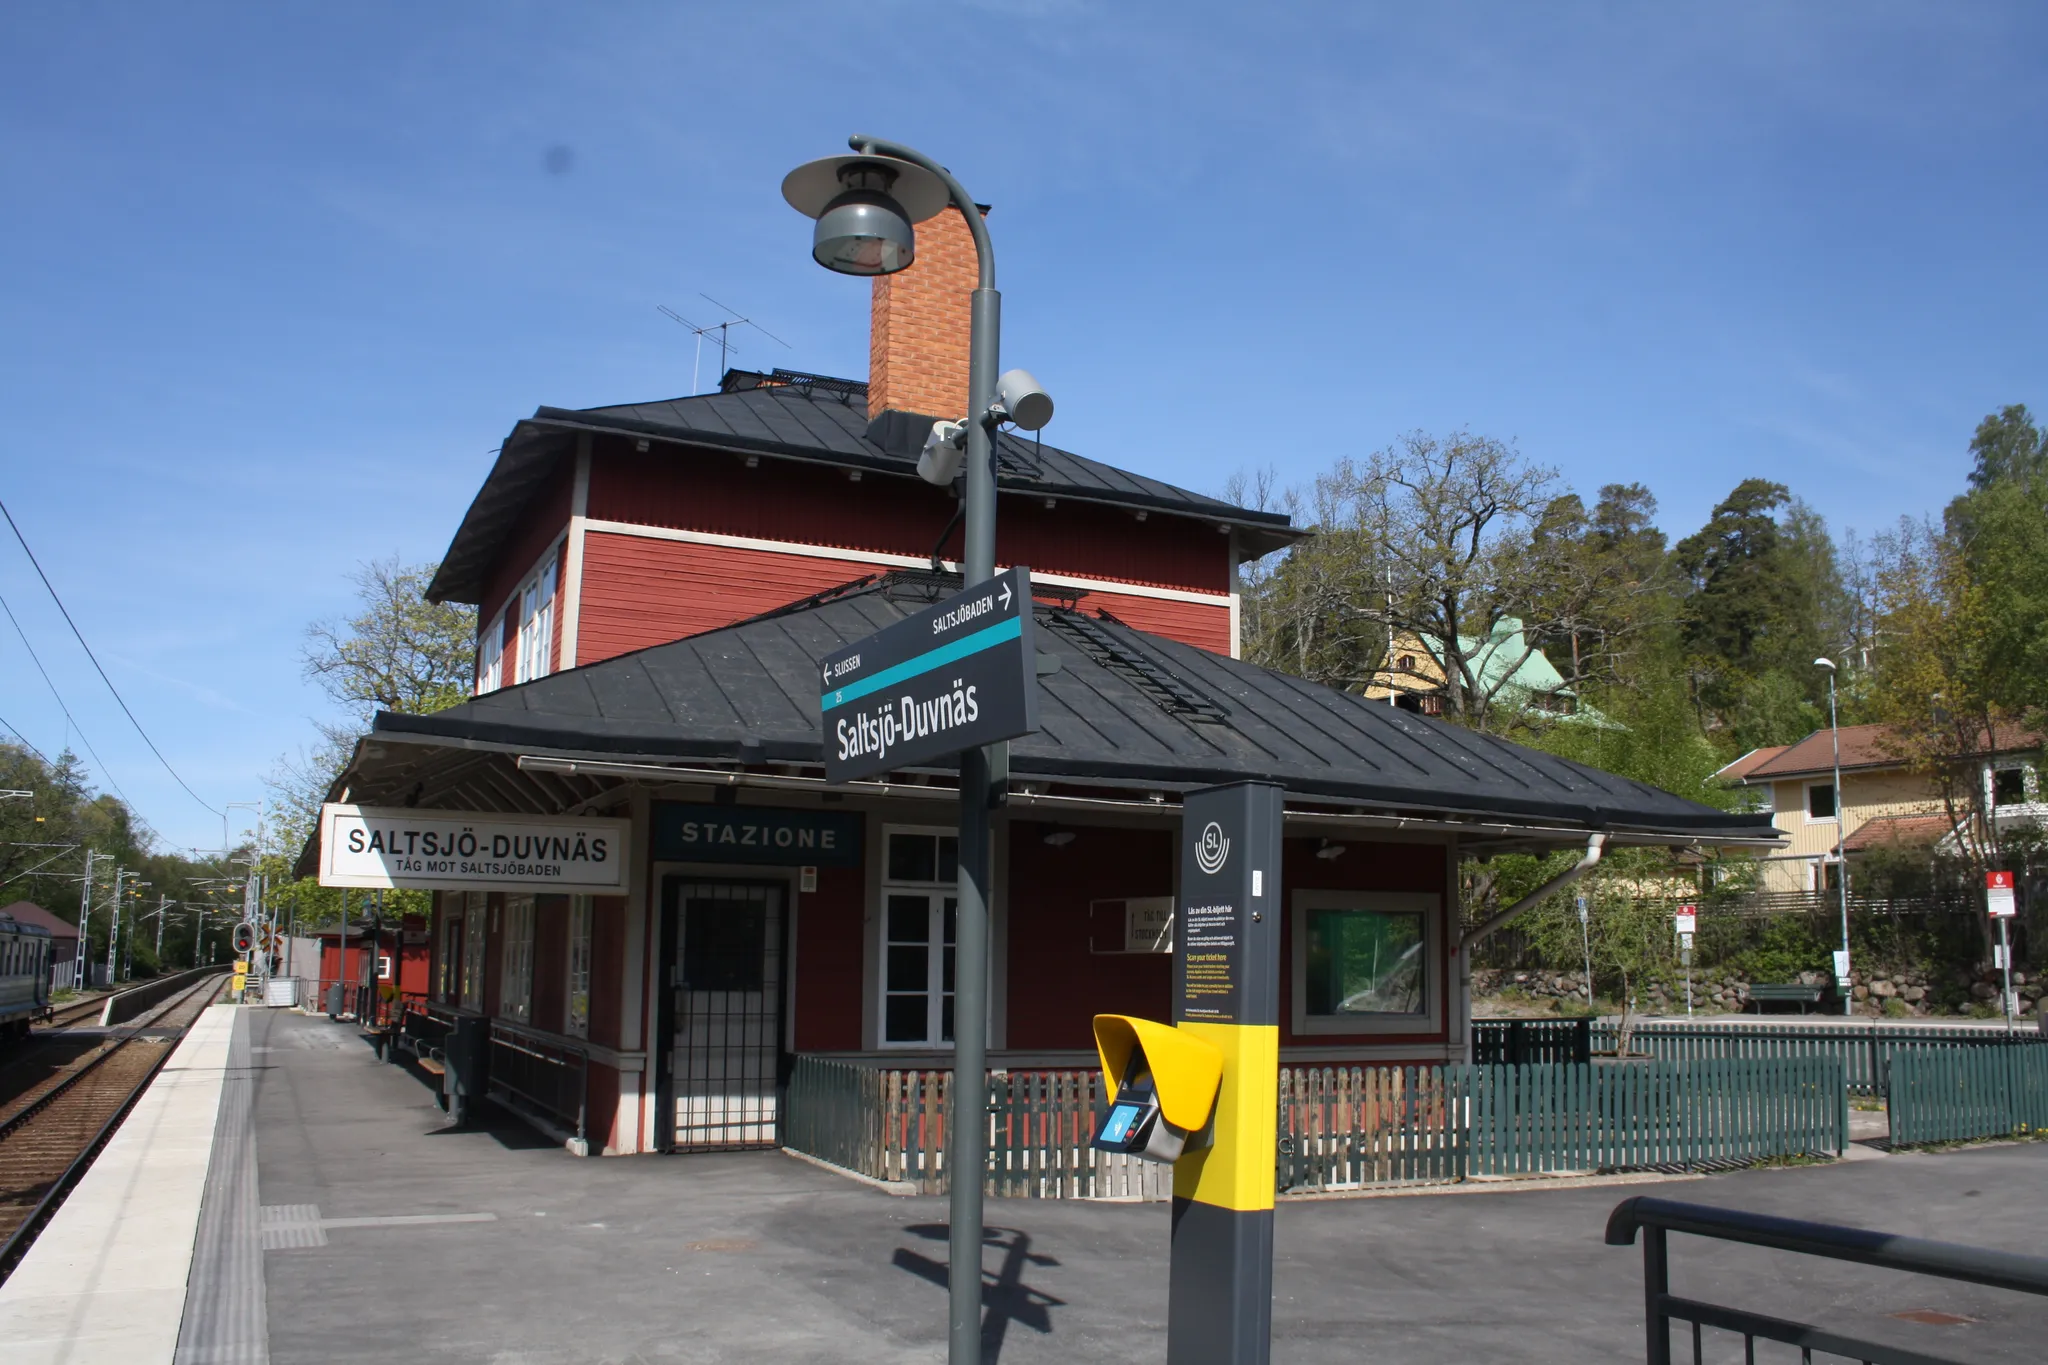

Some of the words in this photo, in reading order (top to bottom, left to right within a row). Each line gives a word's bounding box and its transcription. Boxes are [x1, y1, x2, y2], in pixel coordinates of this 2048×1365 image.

[933, 594, 994, 635] SALTSJÖBADEN
[834, 653, 861, 678] SLUSSEN
[835, 691, 843, 703] 25
[837, 678, 979, 761] Saltsjö-Duvnäs
[348, 826, 608, 863] SALTSJÖ-DUVNÄS
[682, 822, 836, 849] STAZIONE
[1206, 832, 1219, 849] SL
[396, 856, 422, 872] TÅG
[427, 860, 457, 873] MOT
[460, 860, 561, 877] SALTSJÖBADEN
